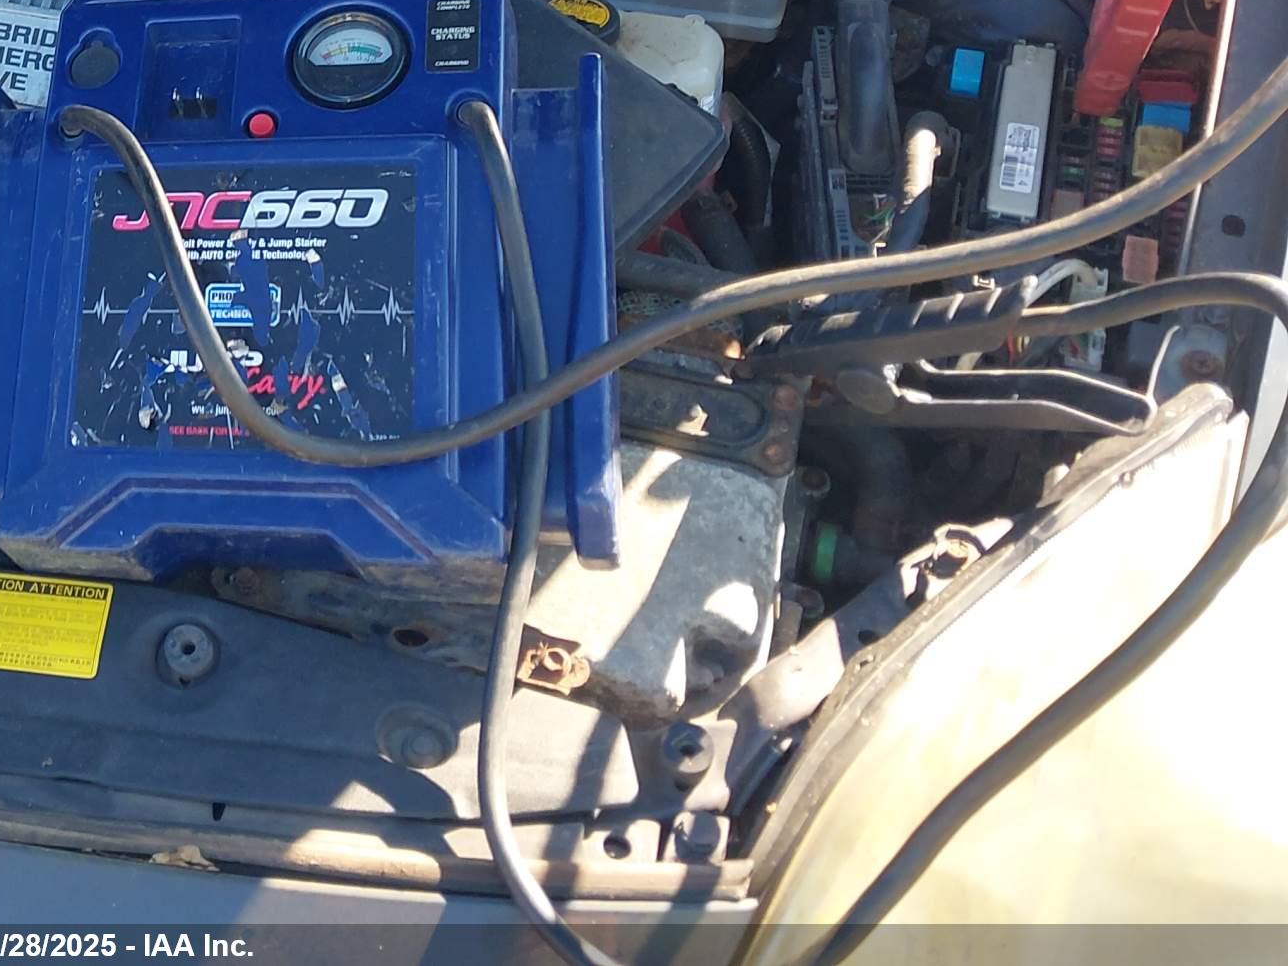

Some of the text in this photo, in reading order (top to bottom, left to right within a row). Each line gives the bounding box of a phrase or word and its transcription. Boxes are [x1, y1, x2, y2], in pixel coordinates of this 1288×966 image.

[431, 26, 475, 35] CHARGING
[435, 33, 471, 41] STATUS
[183, 238, 195, 248] olt
[197, 238, 226, 248] Power
[259, 238, 267, 248] &
[268, 238, 292, 250] Jump
[294, 237, 327, 248] Starter
[200, 250, 224, 260] AUTO
[263, 250, 307, 261] Technolog
[29, 584, 105, 599] ATTENTION
